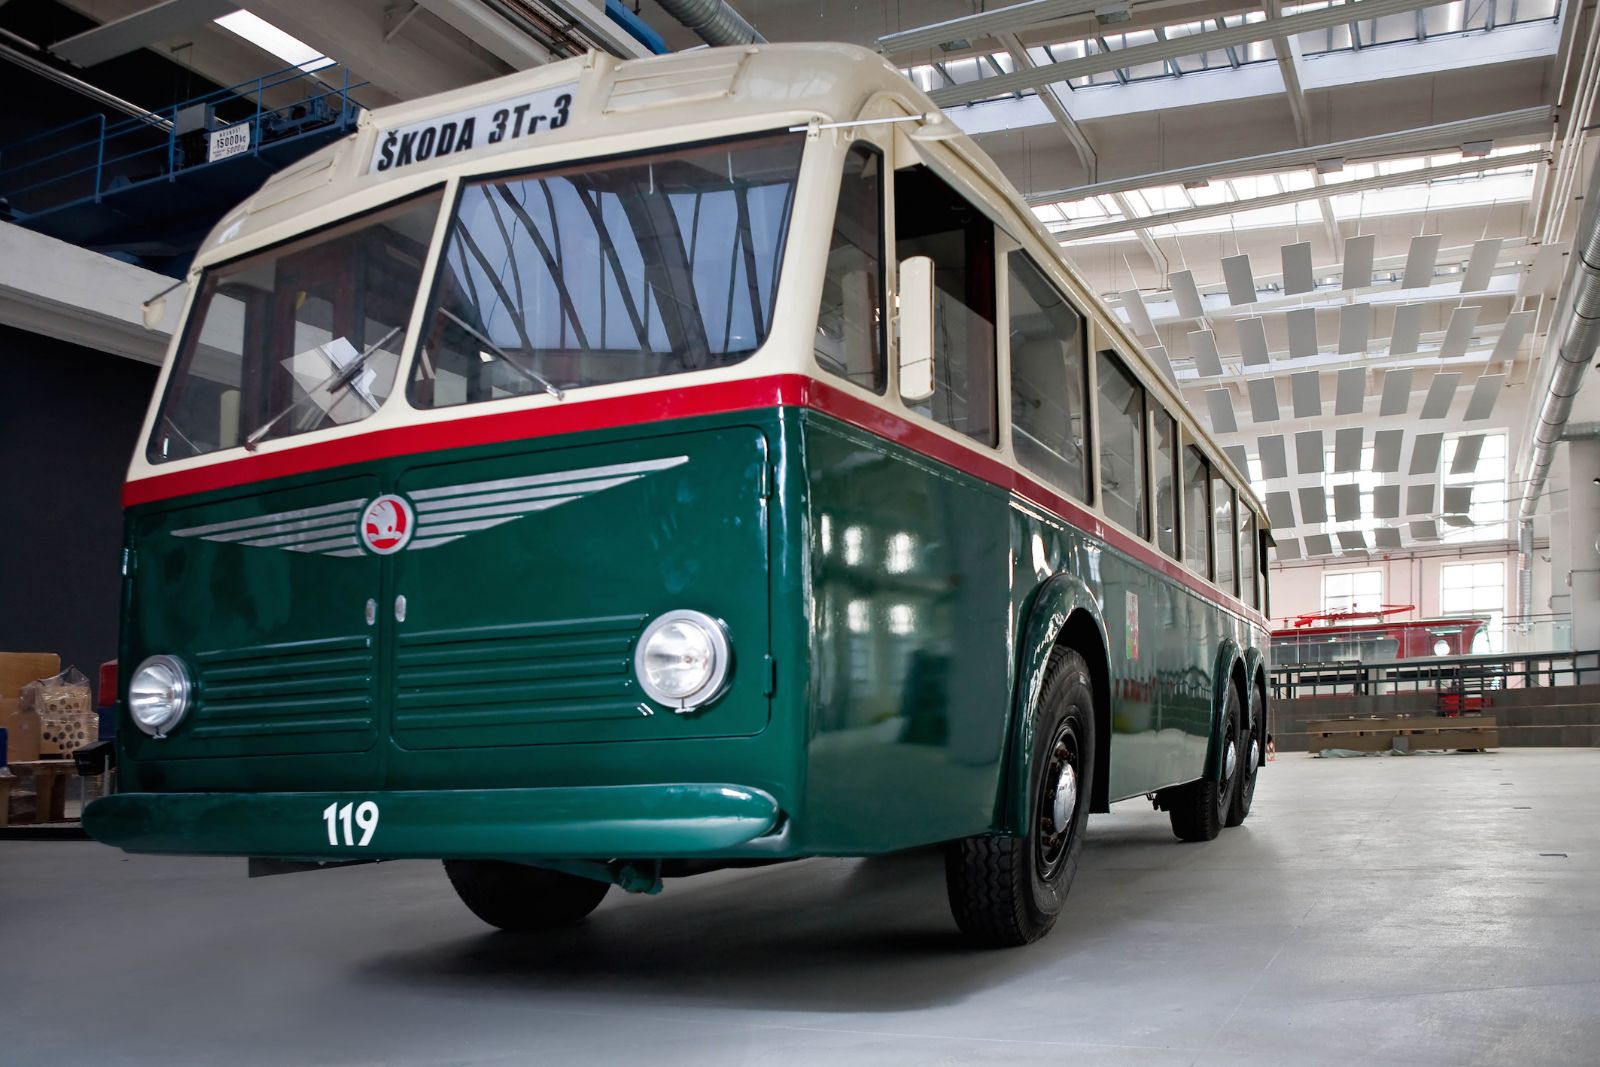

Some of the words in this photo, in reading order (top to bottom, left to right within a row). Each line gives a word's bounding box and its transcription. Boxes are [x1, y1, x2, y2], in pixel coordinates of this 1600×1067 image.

[377, 117, 476, 171] ŠKODA
[488, 94, 572, 144] 3Tr3
[323, 801, 379, 846] 119
